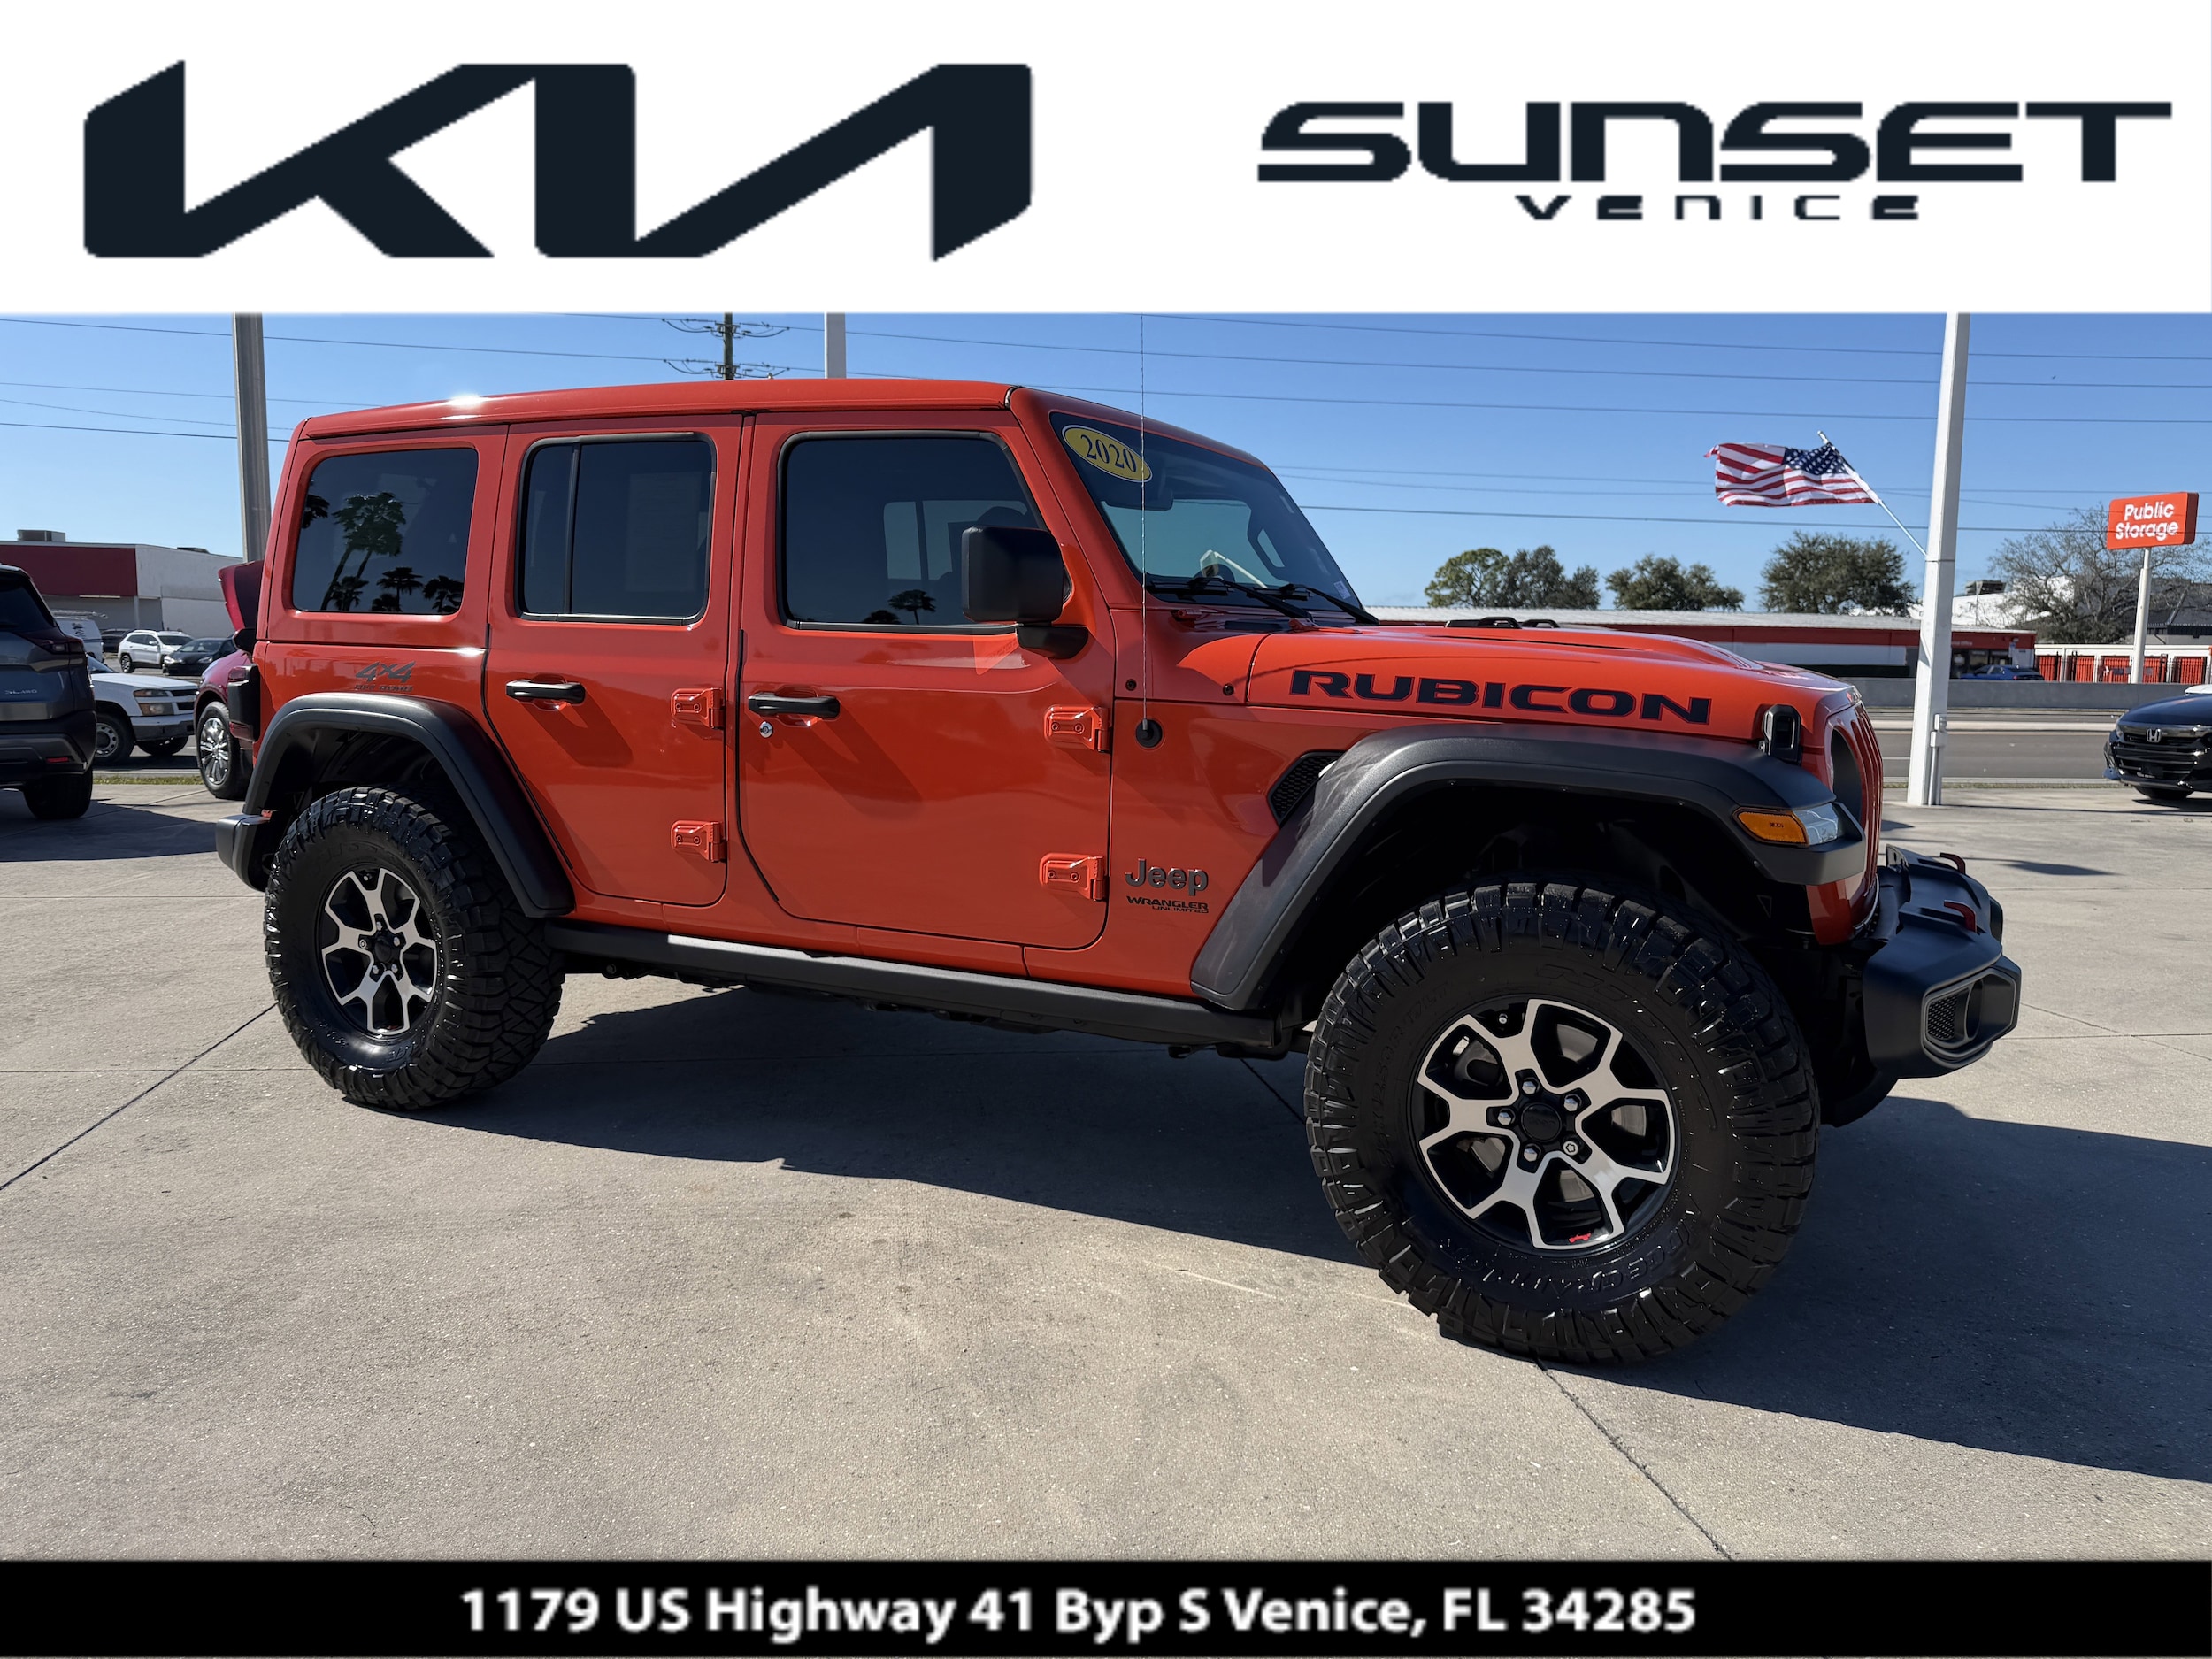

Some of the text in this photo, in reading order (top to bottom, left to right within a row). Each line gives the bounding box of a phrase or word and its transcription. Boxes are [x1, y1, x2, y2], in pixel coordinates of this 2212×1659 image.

[1080, 434, 1137, 472] 2020
[2124, 501, 2175, 521] Public
[2115, 521, 2179, 541] Storage
[1289, 669, 1711, 725] RUBICON
[1125, 858, 1209, 896] Jeep
[1126, 895, 1209, 910] WRANGLER
